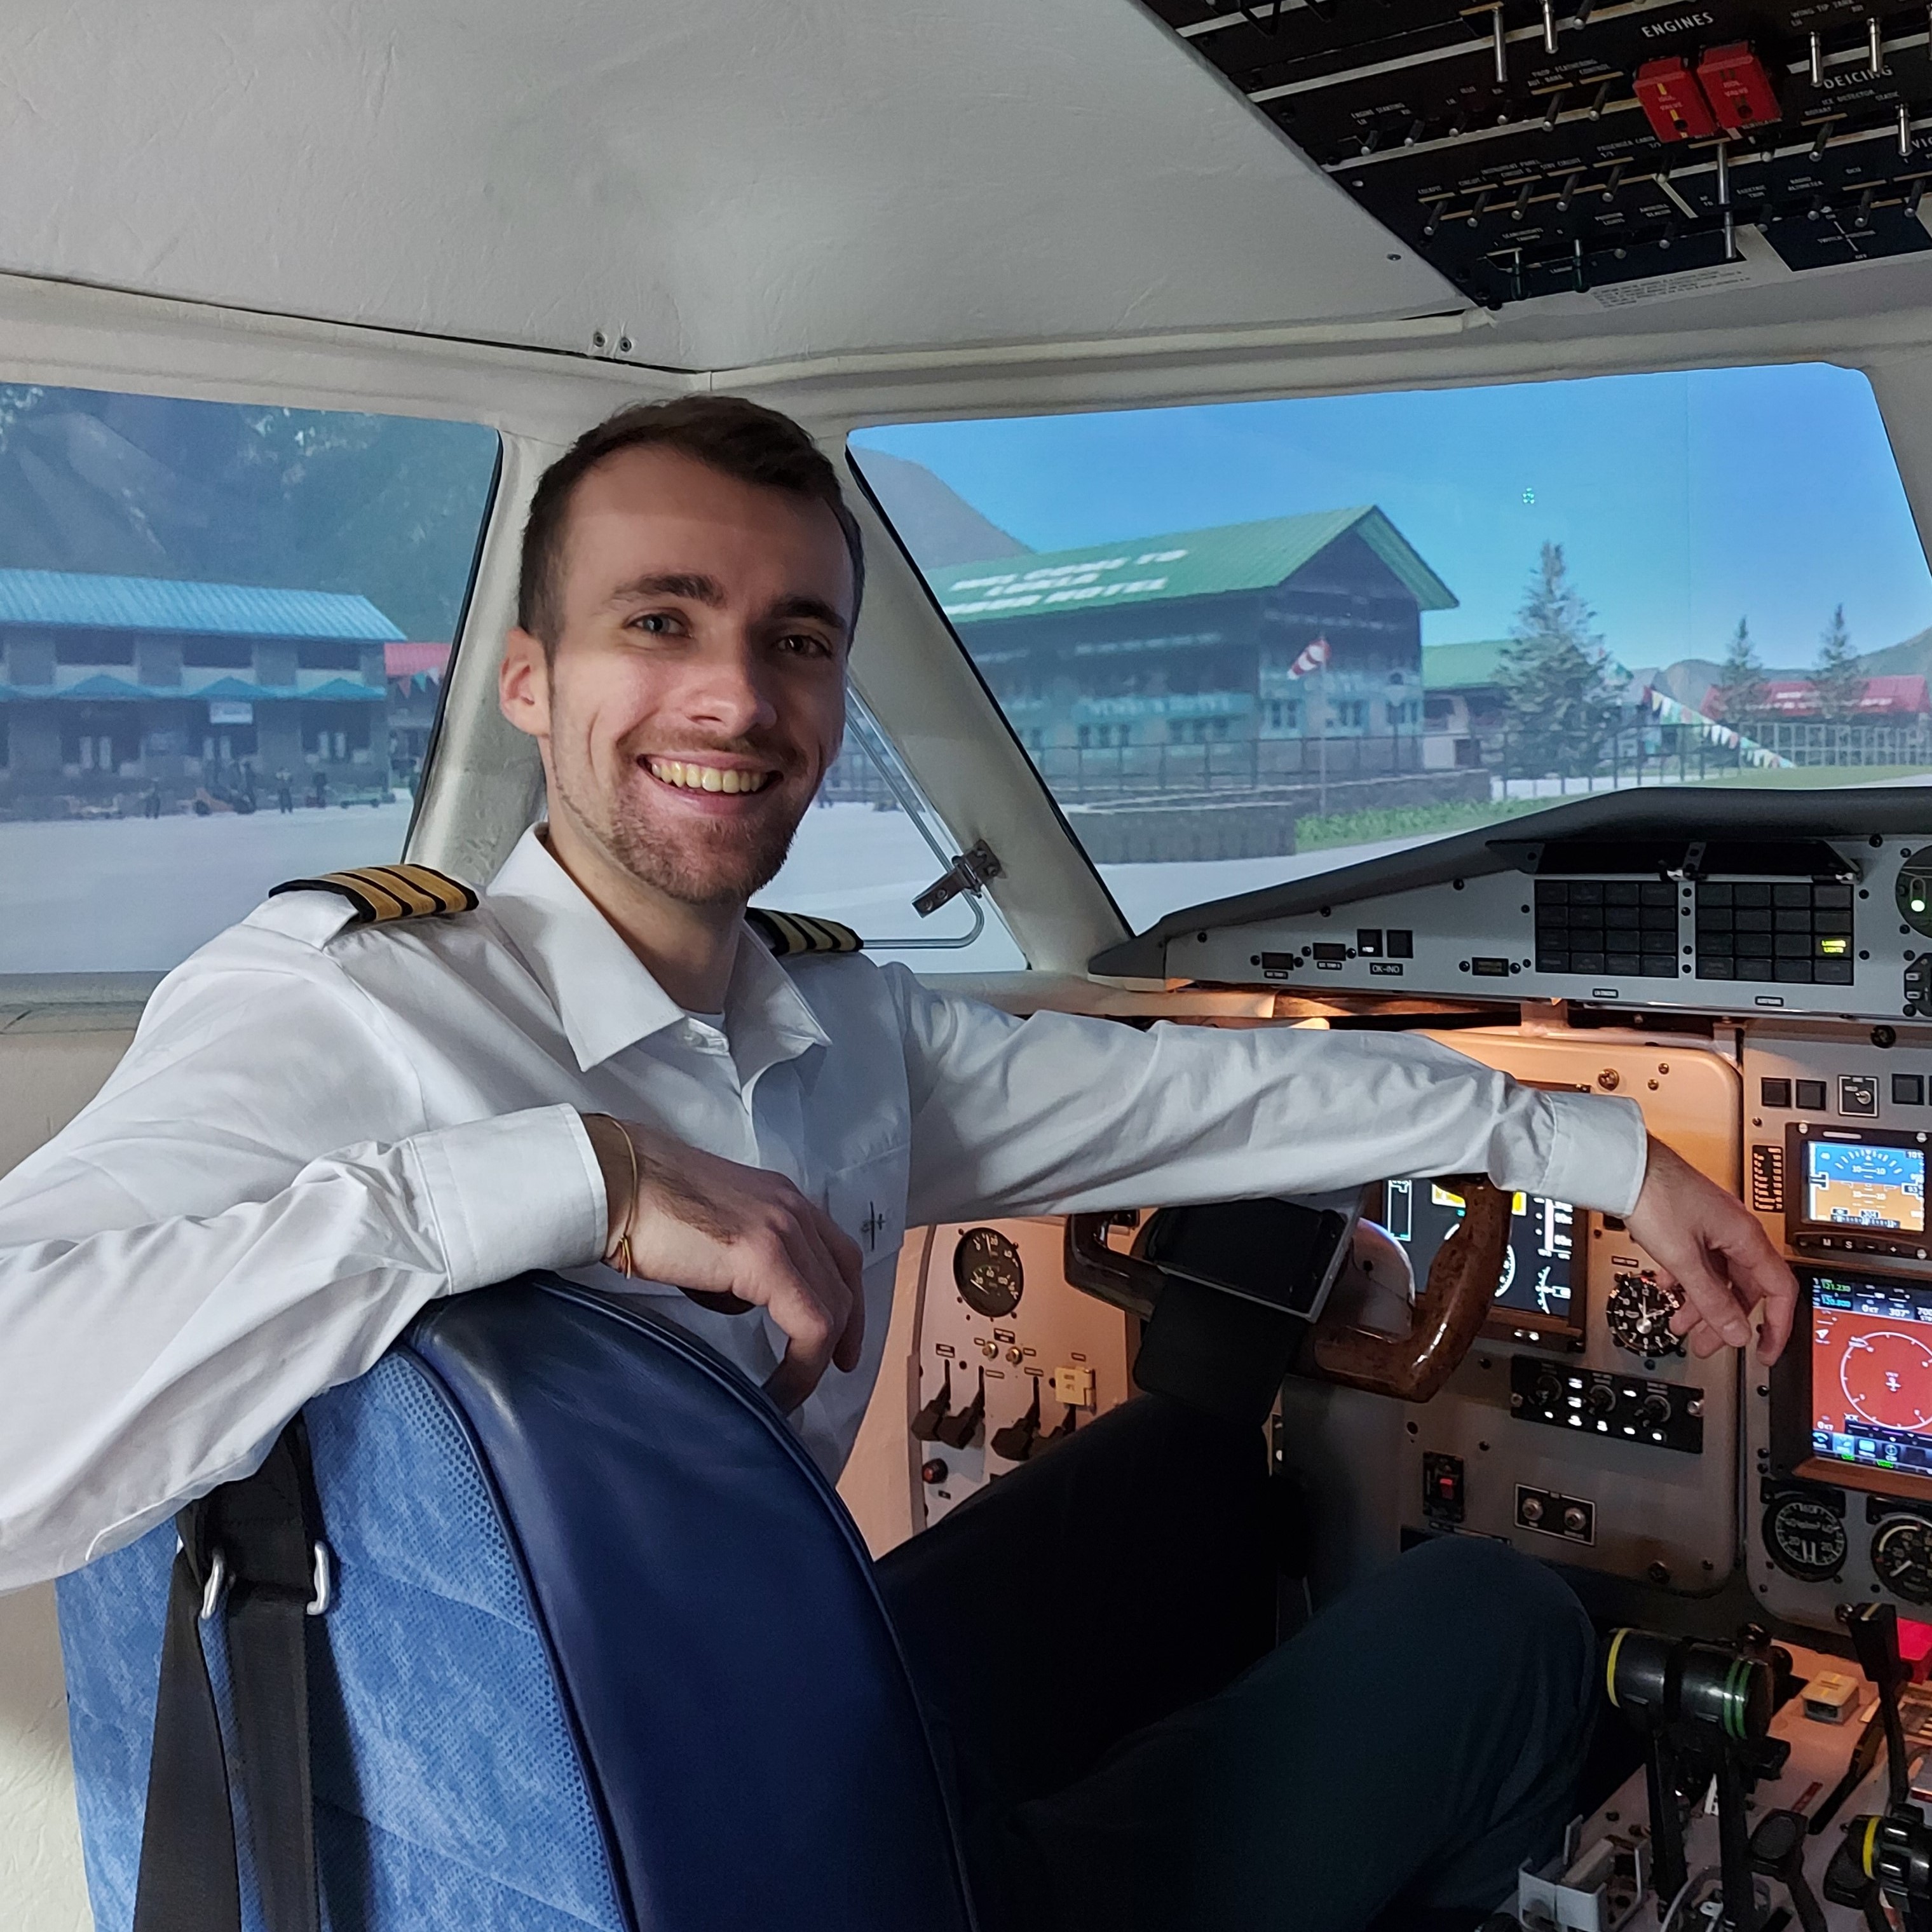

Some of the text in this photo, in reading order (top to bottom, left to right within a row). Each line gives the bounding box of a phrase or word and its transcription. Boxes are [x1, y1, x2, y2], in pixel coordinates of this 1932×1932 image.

[1641, 11, 1715, 37] ENGINES
[1823, 65, 1894, 89] DEICING
[1846, 1241, 1853, 1249] S
